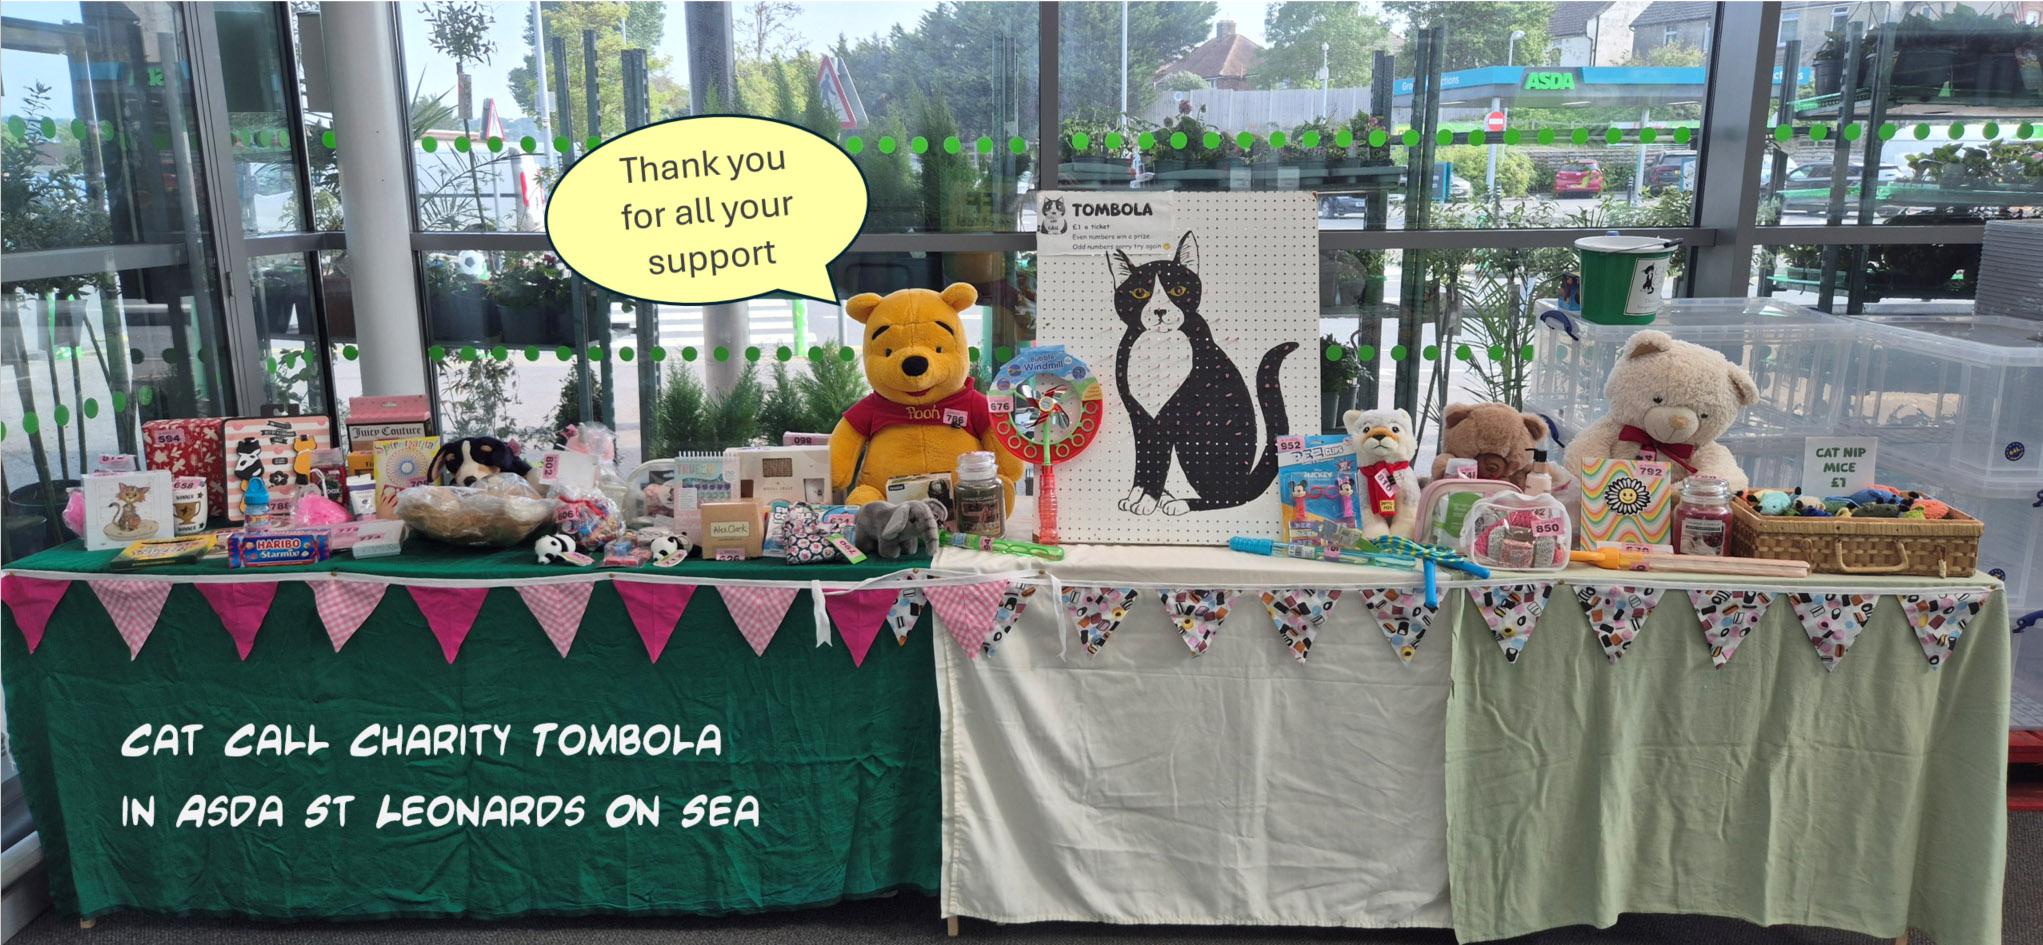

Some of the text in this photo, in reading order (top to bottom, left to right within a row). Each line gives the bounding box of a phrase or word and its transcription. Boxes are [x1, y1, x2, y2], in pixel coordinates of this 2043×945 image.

[1524, 72, 1575, 90] ASDA
[1072, 202, 1153, 217] TOMBOLA
[1134, 234, 1150, 242] prize
[1134, 243, 1144, 251] try
[1146, 244, 1161, 252] again
[1031, 354, 1055, 362] Bubble
[1024, 360, 1064, 371] Windmill
[906, 404, 941, 419] Pooh
[990, 402, 1010, 411] 676
[352, 426, 422, 438] Juicy Couture
[158, 434, 180, 443] 594
[1280, 441, 1301, 450] 952
[1816, 447, 1866, 458] CAT NIP
[544, 455, 554, 476] 802
[1823, 462, 1856, 472] MICE
[1639, 466, 1663, 477] 792
[1831, 477, 1846, 488] £1
[713, 524, 747, 533] Alex Clark
[1536, 523, 1560, 533] 850
[257, 539, 301, 550] HARIBO
[260, 548, 298, 559] Starmix
